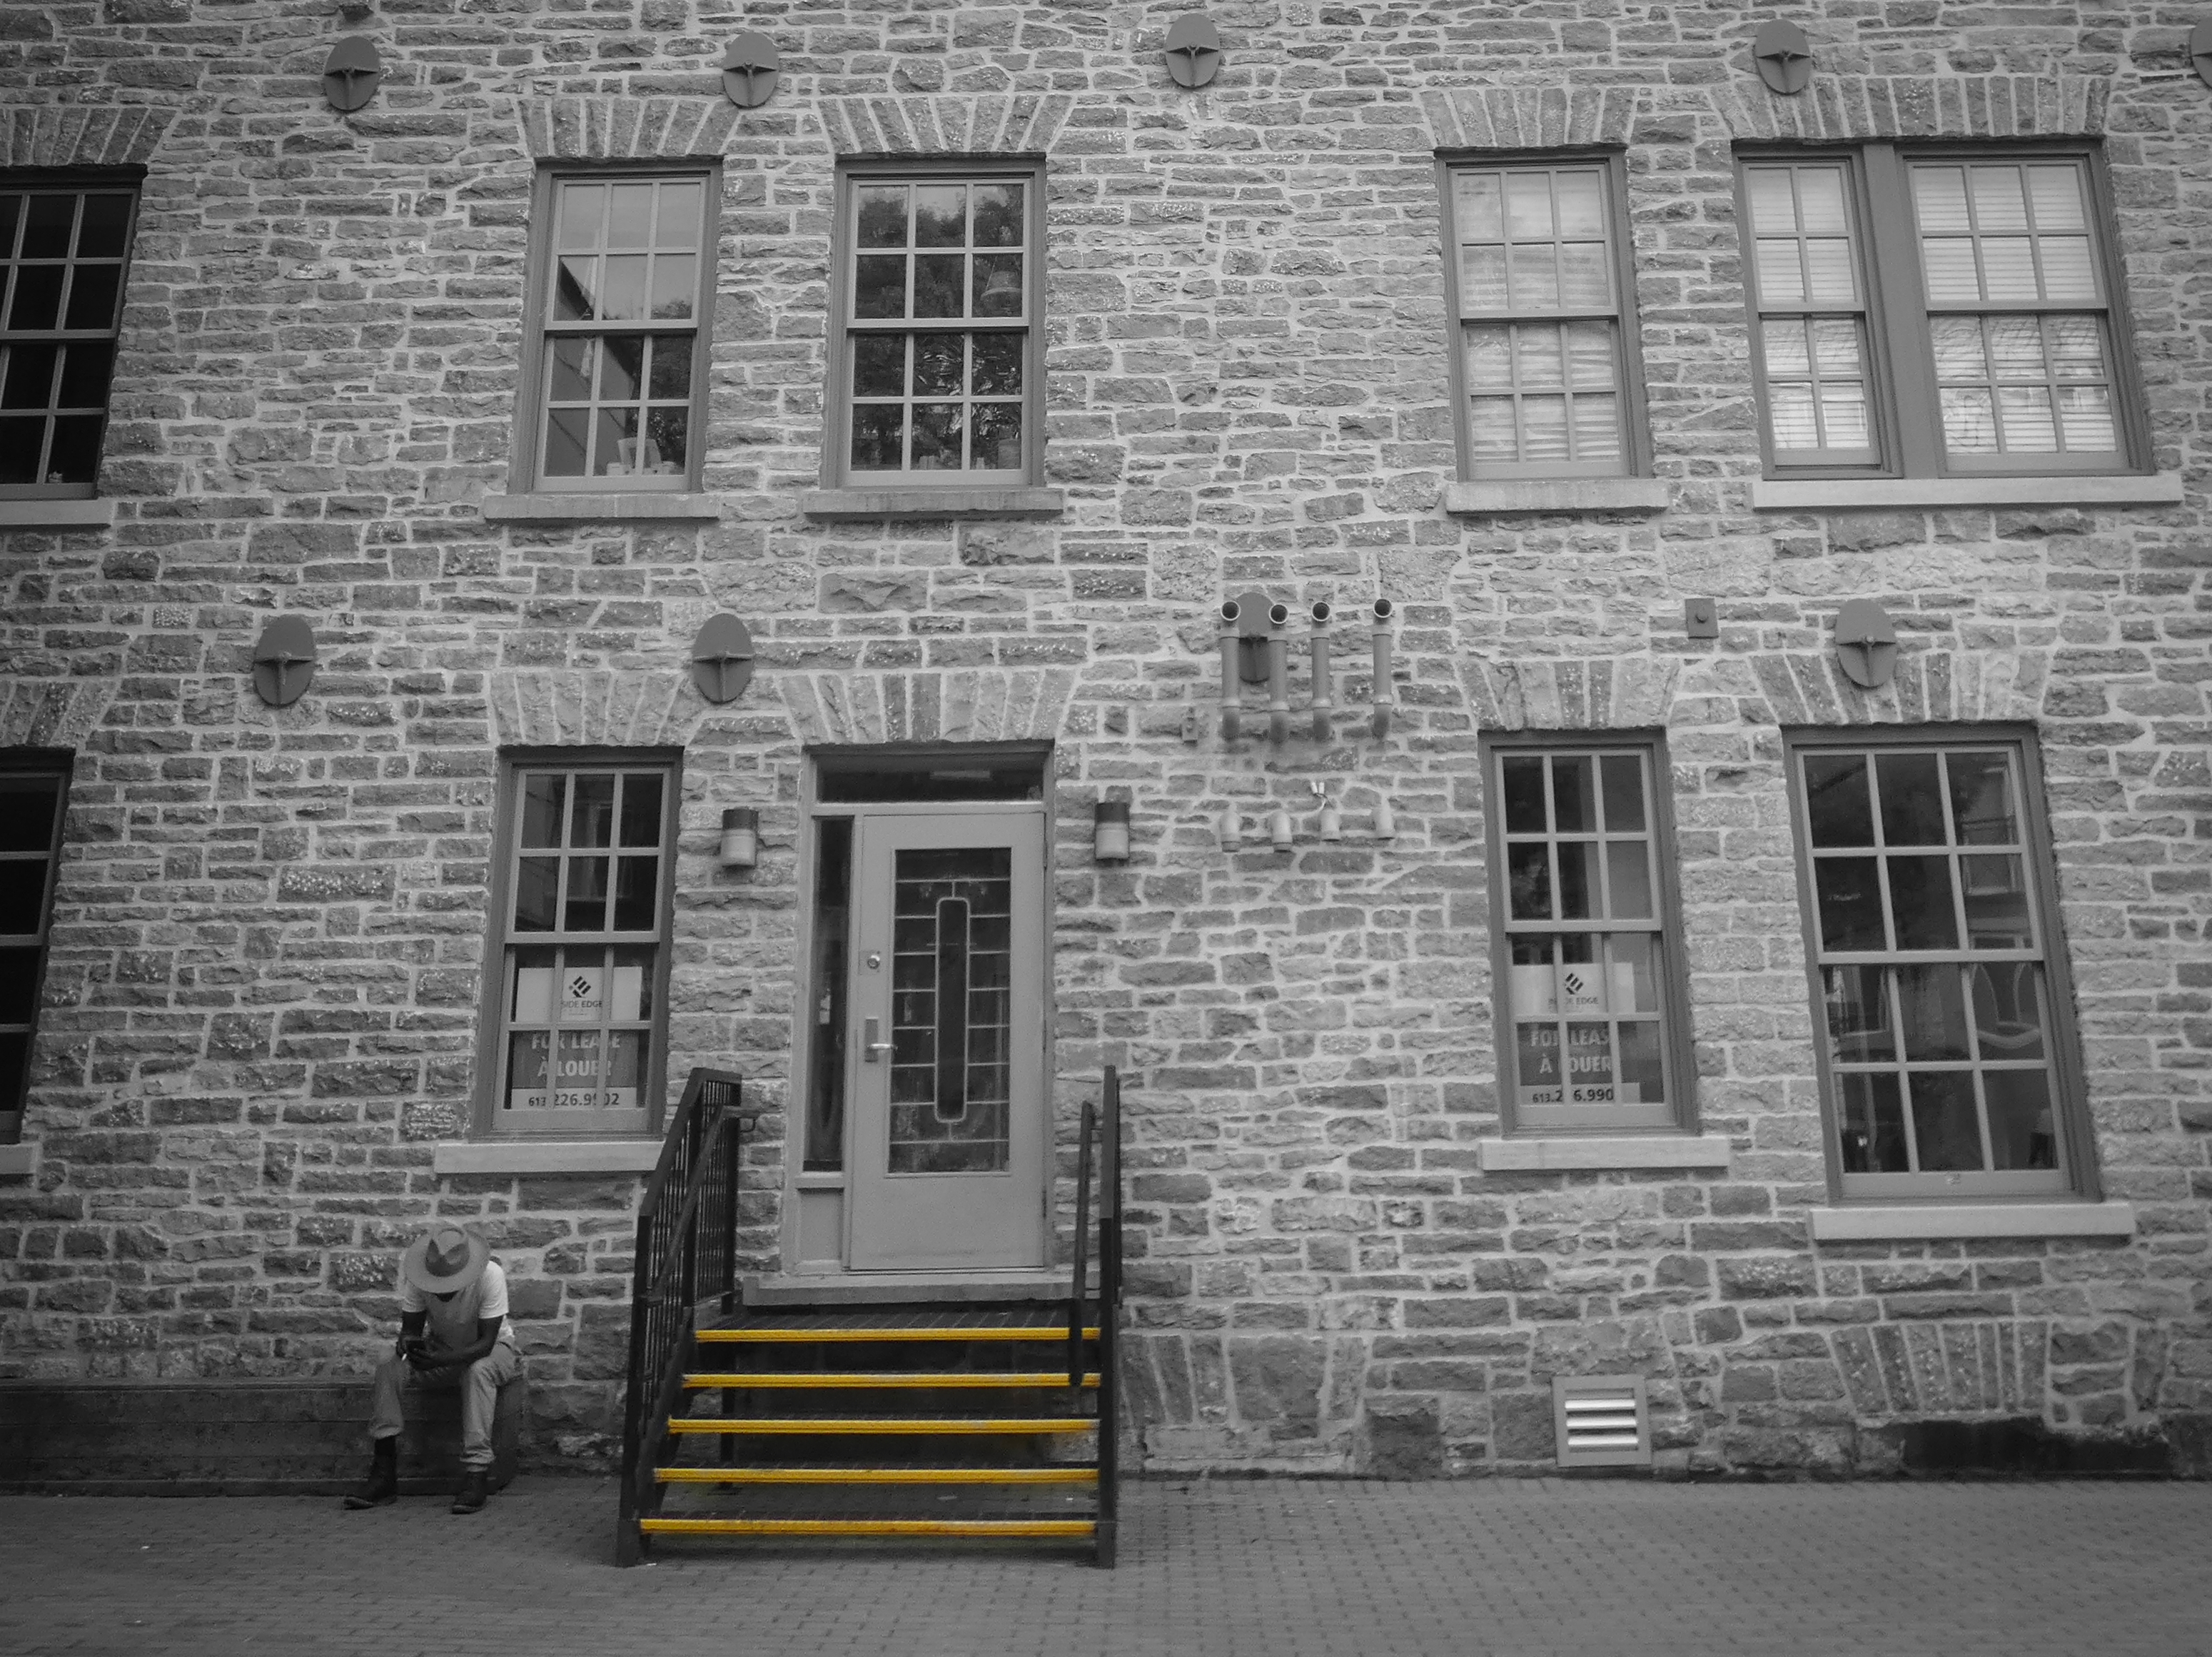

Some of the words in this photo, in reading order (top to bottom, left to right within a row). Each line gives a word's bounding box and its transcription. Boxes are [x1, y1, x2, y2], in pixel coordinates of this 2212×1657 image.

[1576, 997, 1599, 1005] EDGE
[571, 1032, 620, 1048] LEAE
[1570, 1029, 1610, 1046] LEAS
[1540, 1054, 1552, 1074] À
[1559, 1056, 1612, 1073] OUER
[528, 1093, 620, 1107] 613226.902
[1532, 1089, 1615, 1103] 613.26.990
